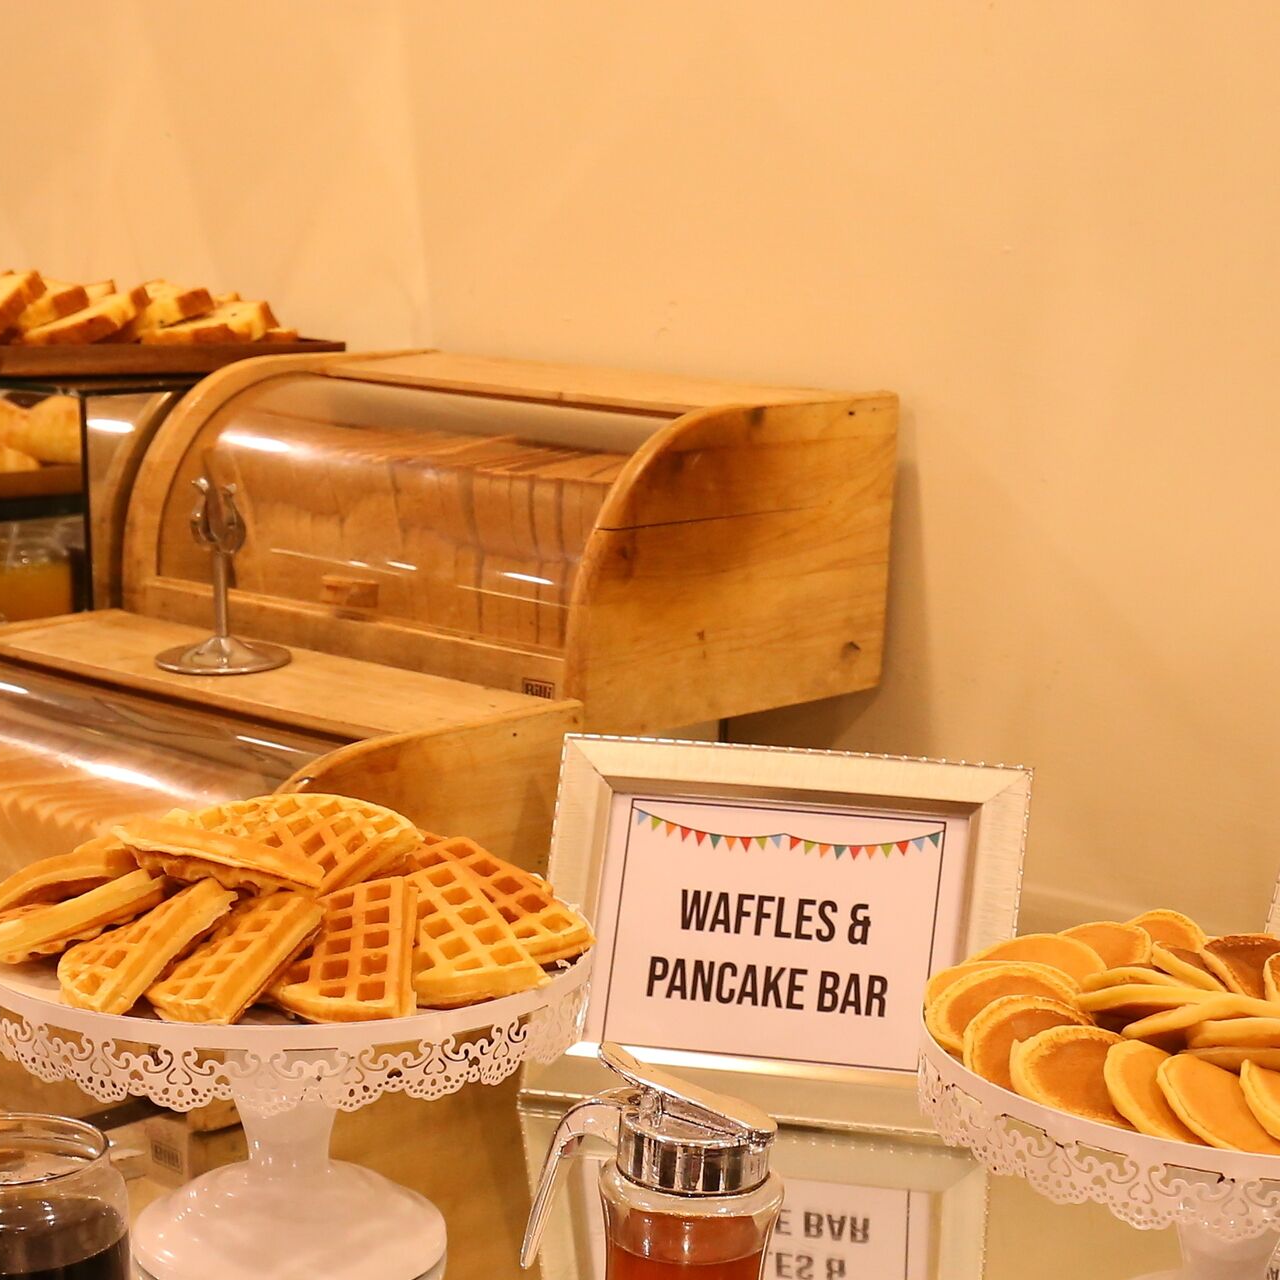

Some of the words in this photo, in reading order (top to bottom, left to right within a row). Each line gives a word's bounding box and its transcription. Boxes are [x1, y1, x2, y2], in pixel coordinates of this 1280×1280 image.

[680, 888, 838, 942] WAFFLES
[847, 903, 871, 945] &
[646, 955, 809, 1010] PANCAKE
[816, 970, 888, 1018] BAR
